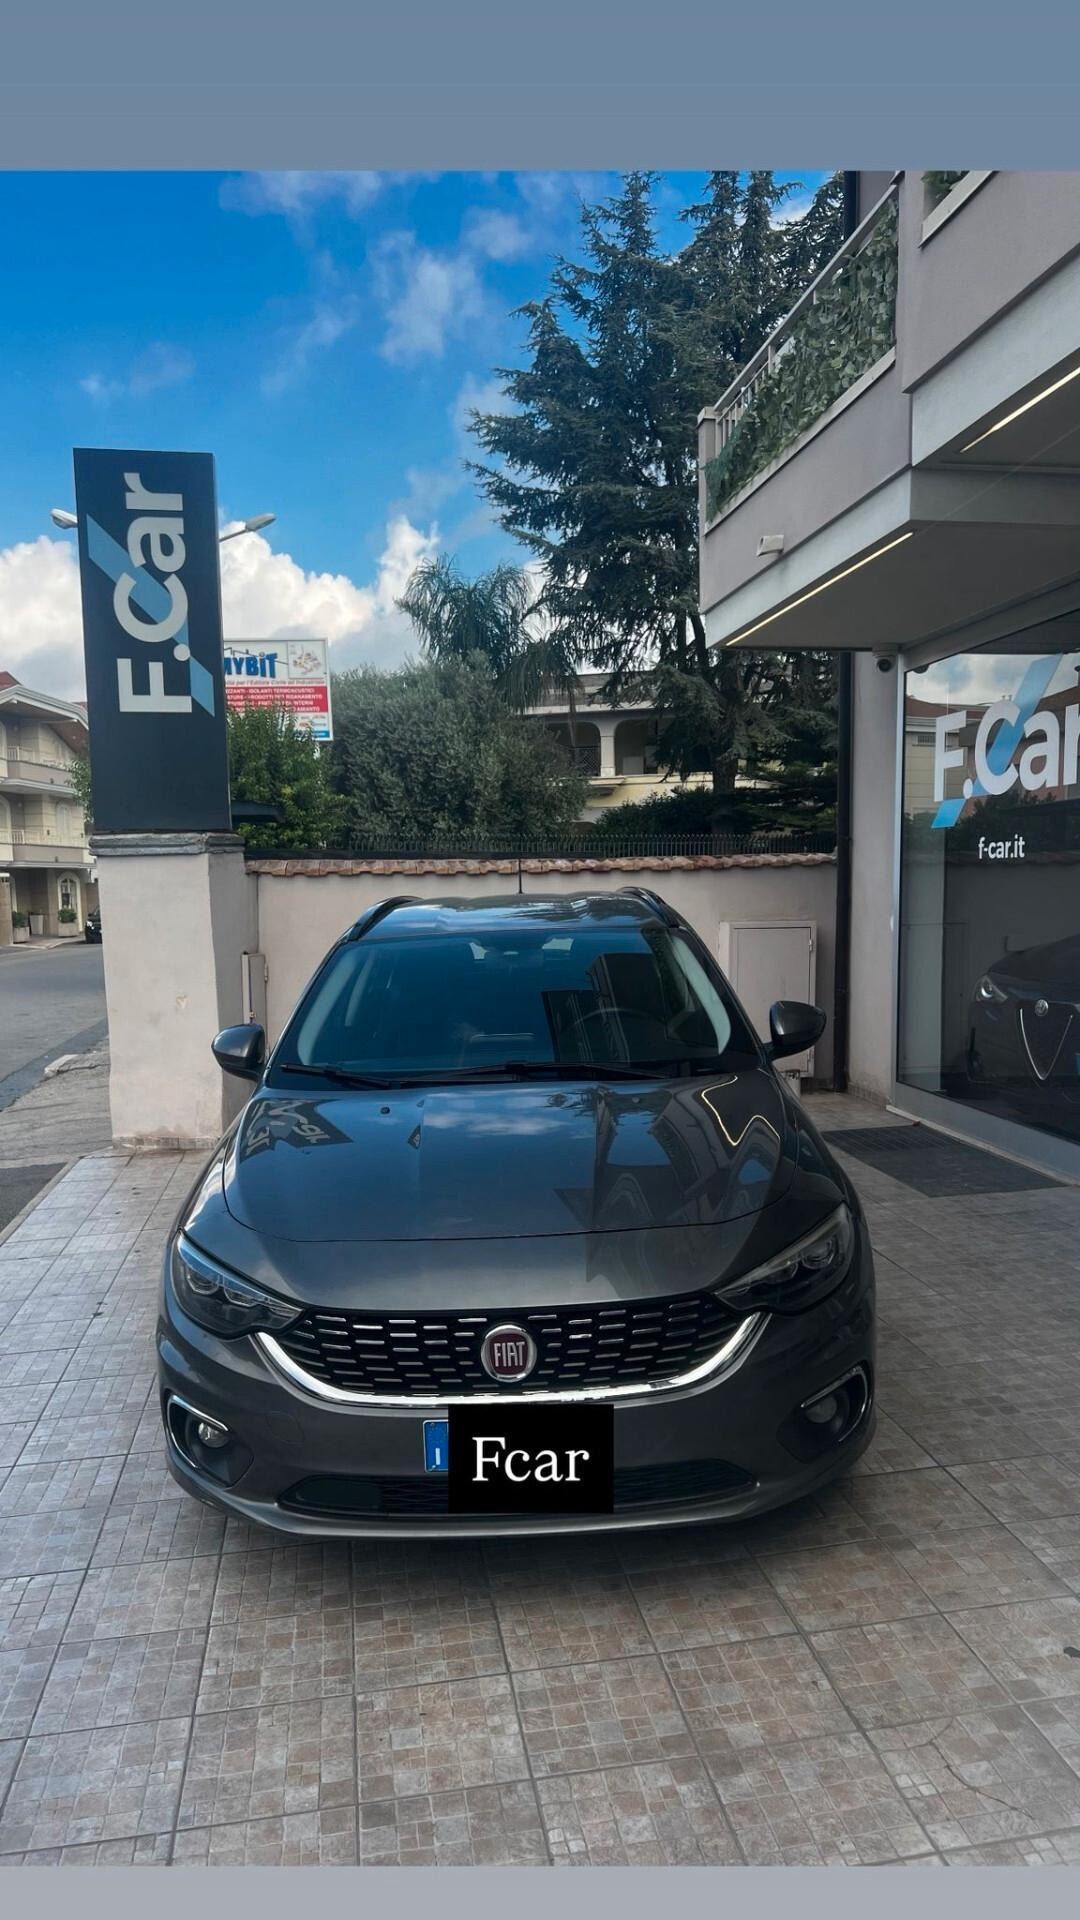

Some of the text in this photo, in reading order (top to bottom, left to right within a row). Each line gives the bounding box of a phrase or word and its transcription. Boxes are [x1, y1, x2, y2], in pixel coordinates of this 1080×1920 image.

[113, 472, 192, 713] F.Car
[978, 834, 1025, 860] f-car.it
[493, 1341, 525, 1368] FIAT
